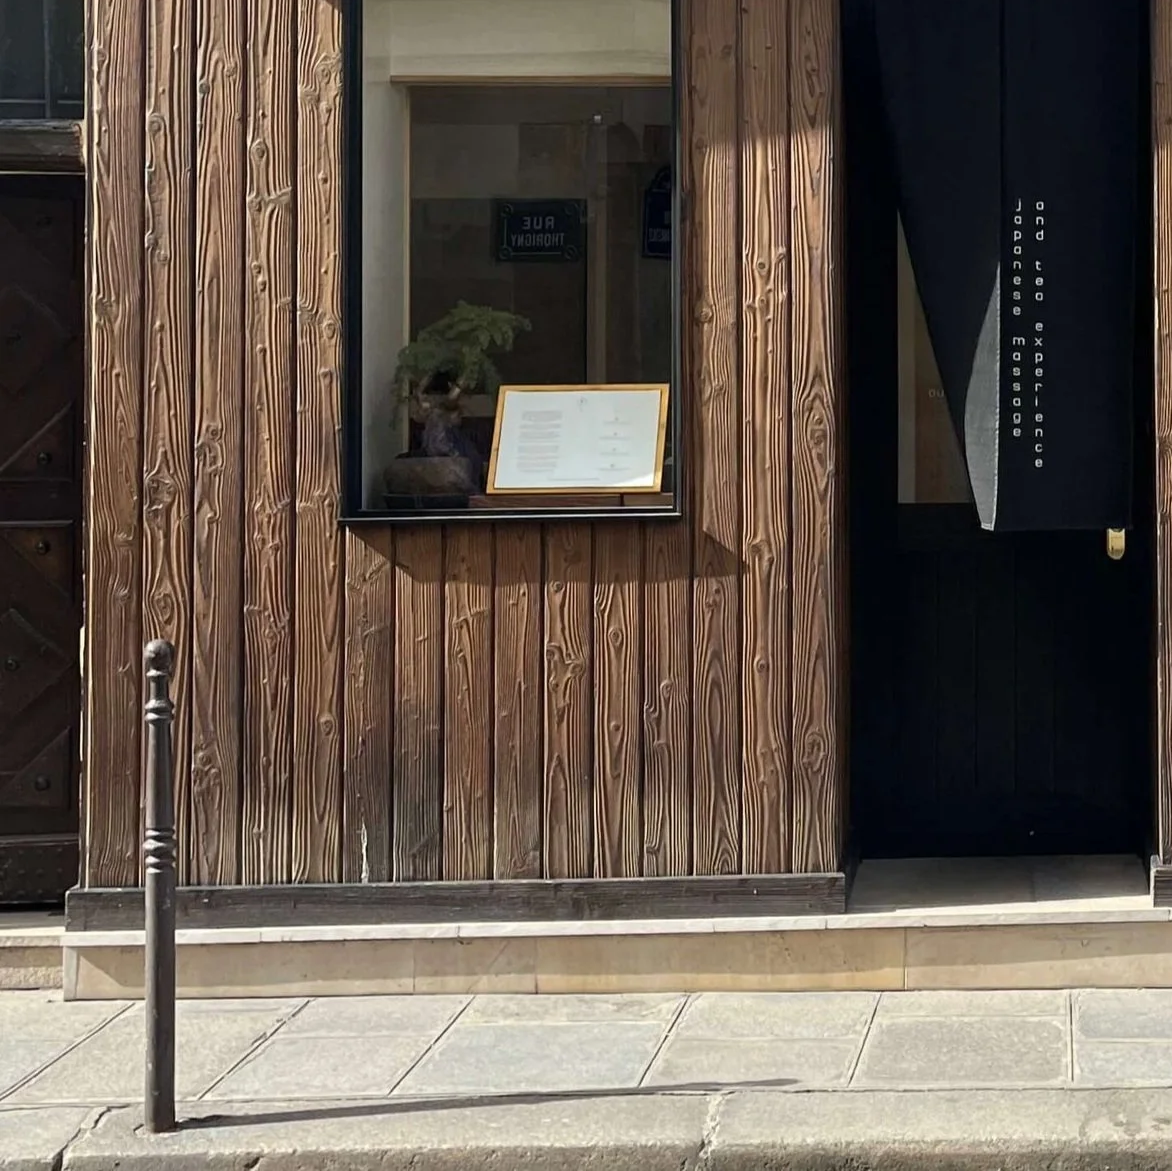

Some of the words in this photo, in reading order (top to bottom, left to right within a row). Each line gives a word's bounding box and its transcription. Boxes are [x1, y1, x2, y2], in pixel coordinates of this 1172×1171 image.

[1035, 200, 1044, 241] and
[1035, 260, 1044, 301] tea
[1012, 336, 1025, 437] massage
[1035, 322, 1043, 468] experience
